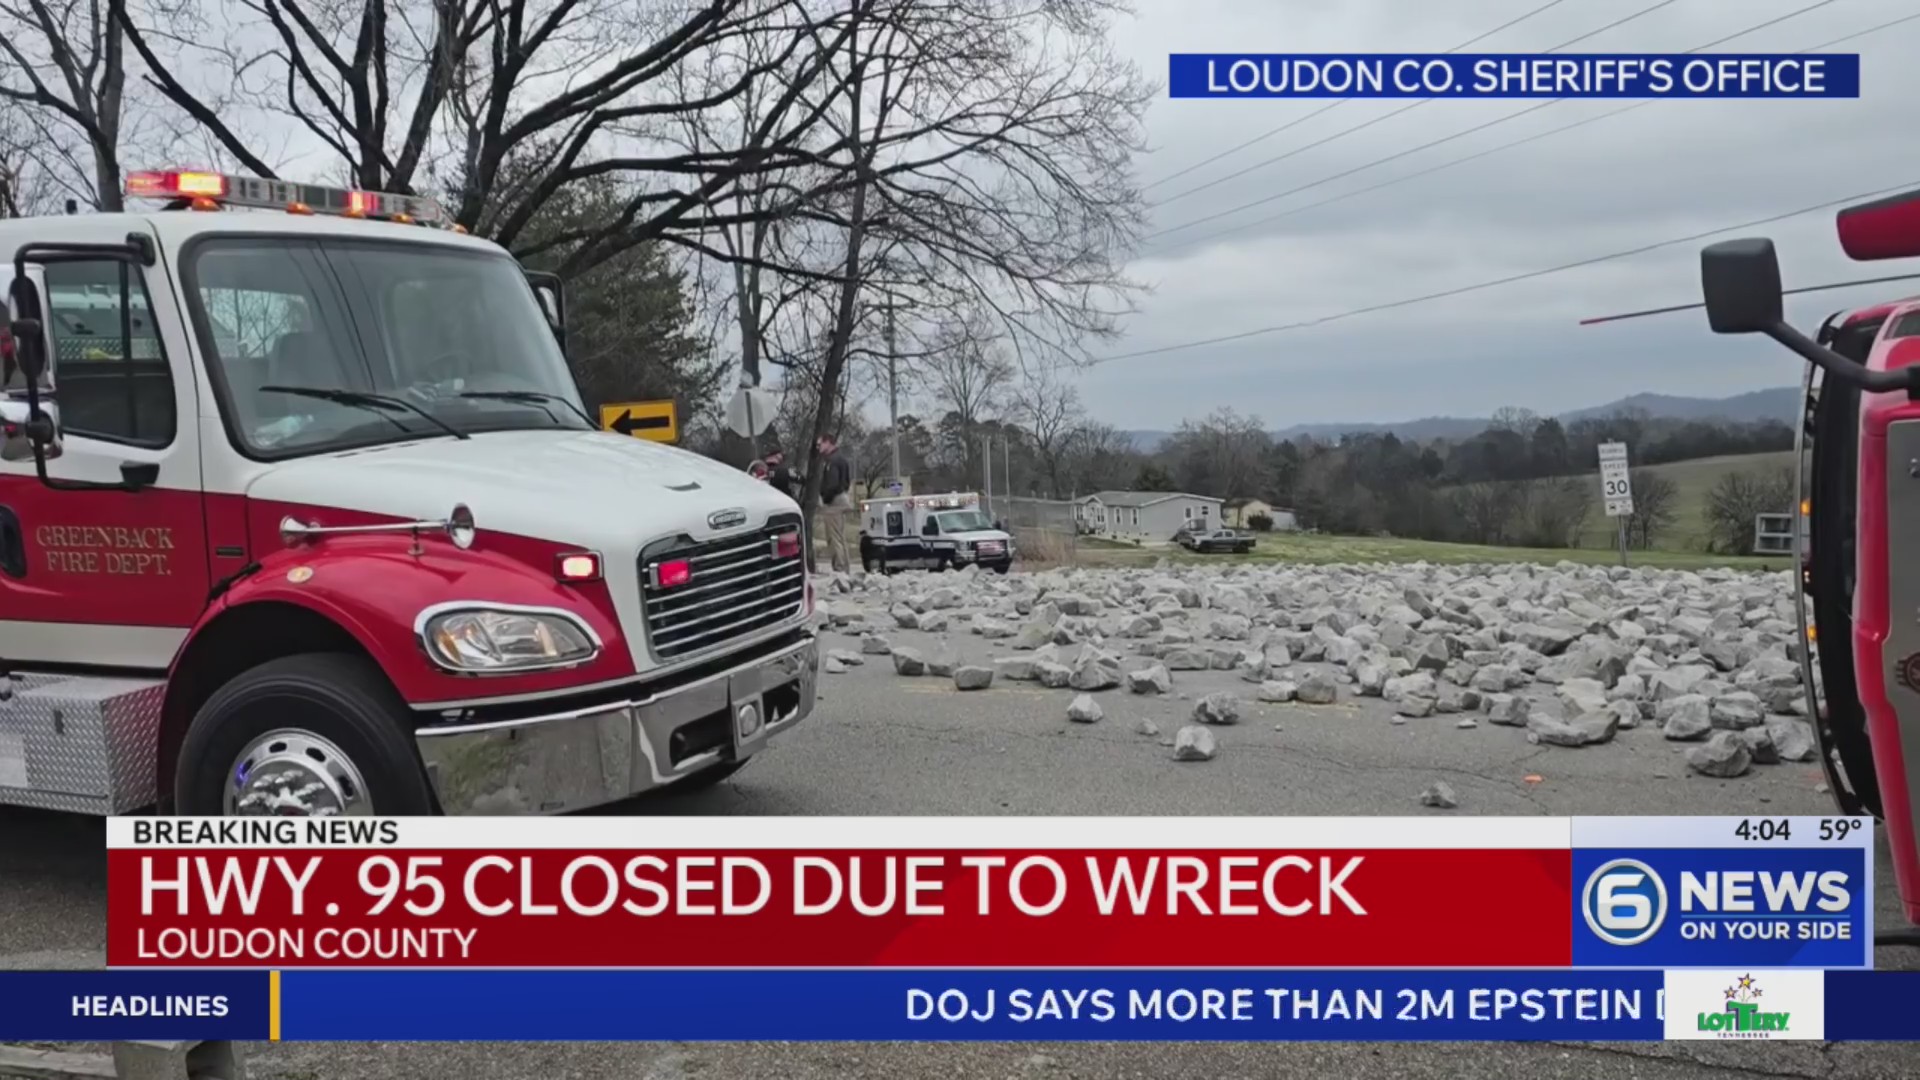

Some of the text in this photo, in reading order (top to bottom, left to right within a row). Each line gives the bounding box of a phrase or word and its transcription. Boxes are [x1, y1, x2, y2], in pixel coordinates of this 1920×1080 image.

[1605, 479, 1628, 496] 30
[36, 525, 175, 549] GREENBACK
[46, 551, 172, 576] FIRE DEPT.
